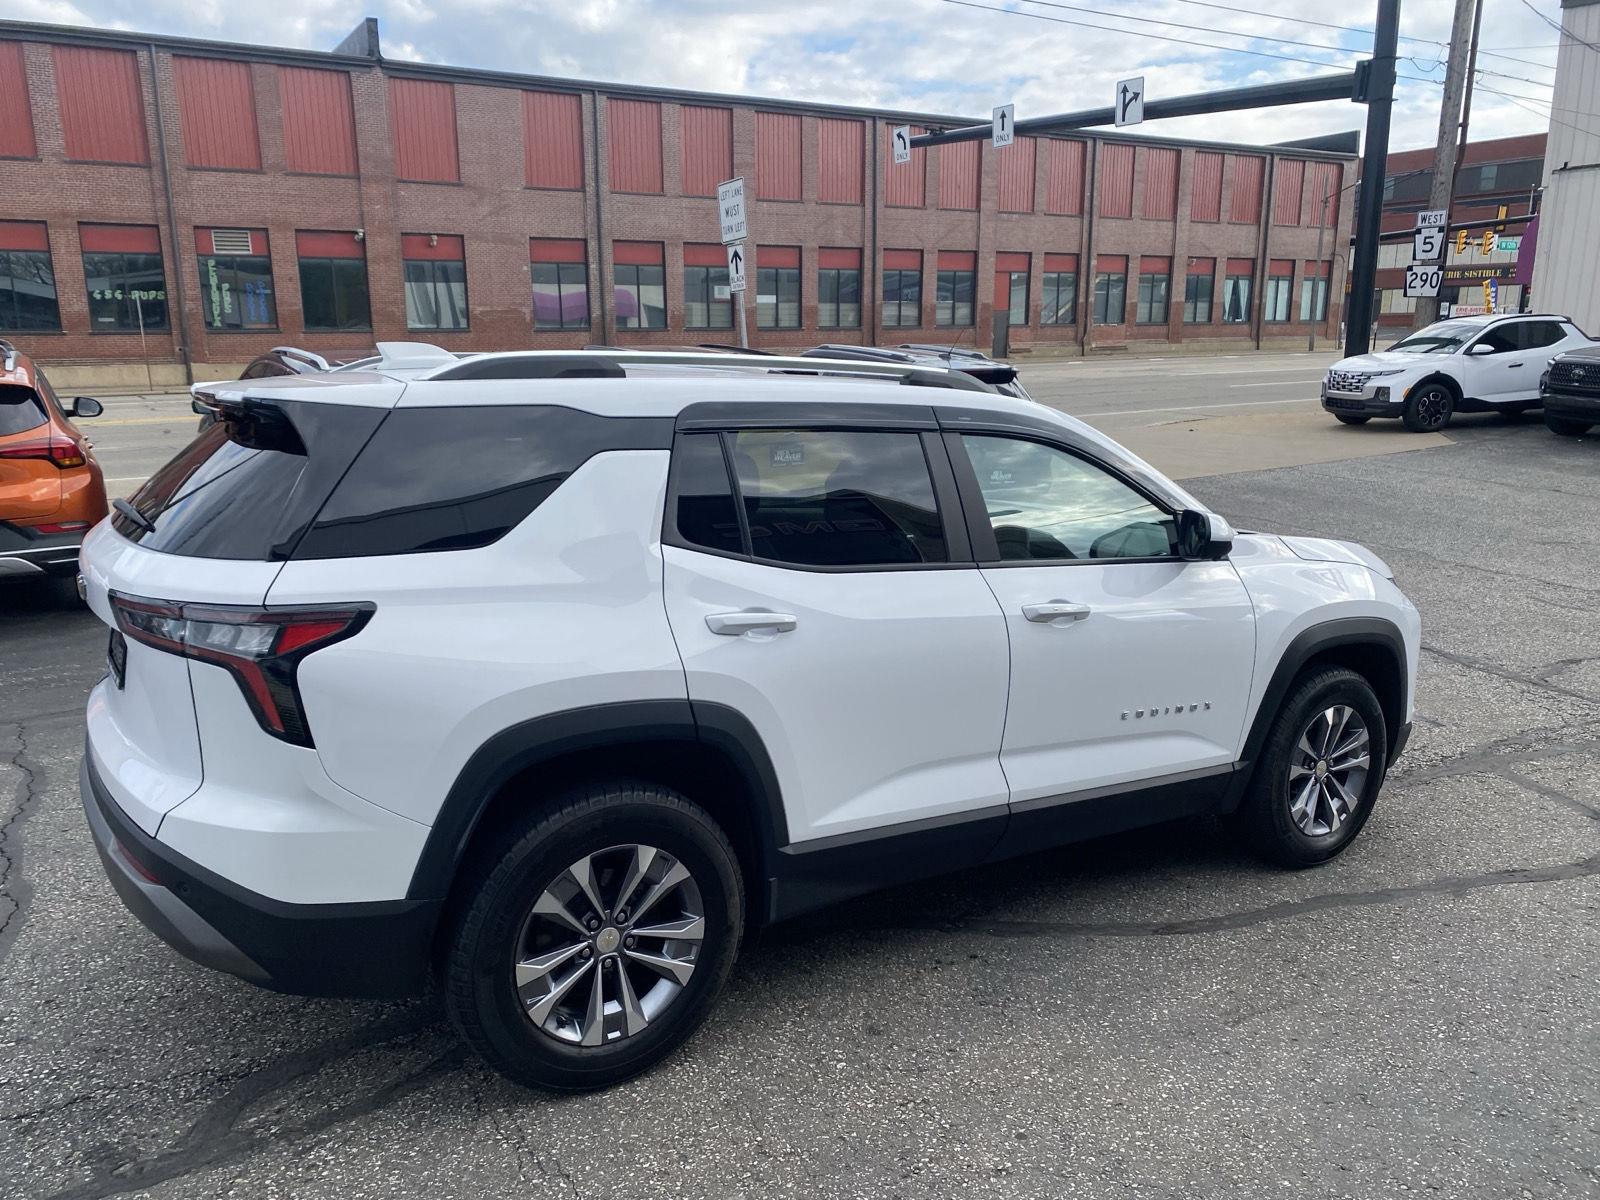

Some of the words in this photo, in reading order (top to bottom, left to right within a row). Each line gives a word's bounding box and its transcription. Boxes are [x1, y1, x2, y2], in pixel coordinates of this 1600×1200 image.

[995, 133, 1010, 143] ONLY
[896, 152, 908, 161] ONLY
[720, 190, 730, 202] LEFT
[731, 186, 743, 198] LANE
[724, 204, 740, 218] MUST
[1420, 214, 1444, 225] WEST
[723, 225, 734, 236] TURN
[735, 221, 745, 233] LEFT
[1422, 236, 1434, 253] 5
[730, 275, 744, 284] BLACK
[1408, 272, 1440, 289] 290
[1120, 701, 1212, 720] EQUINOX
